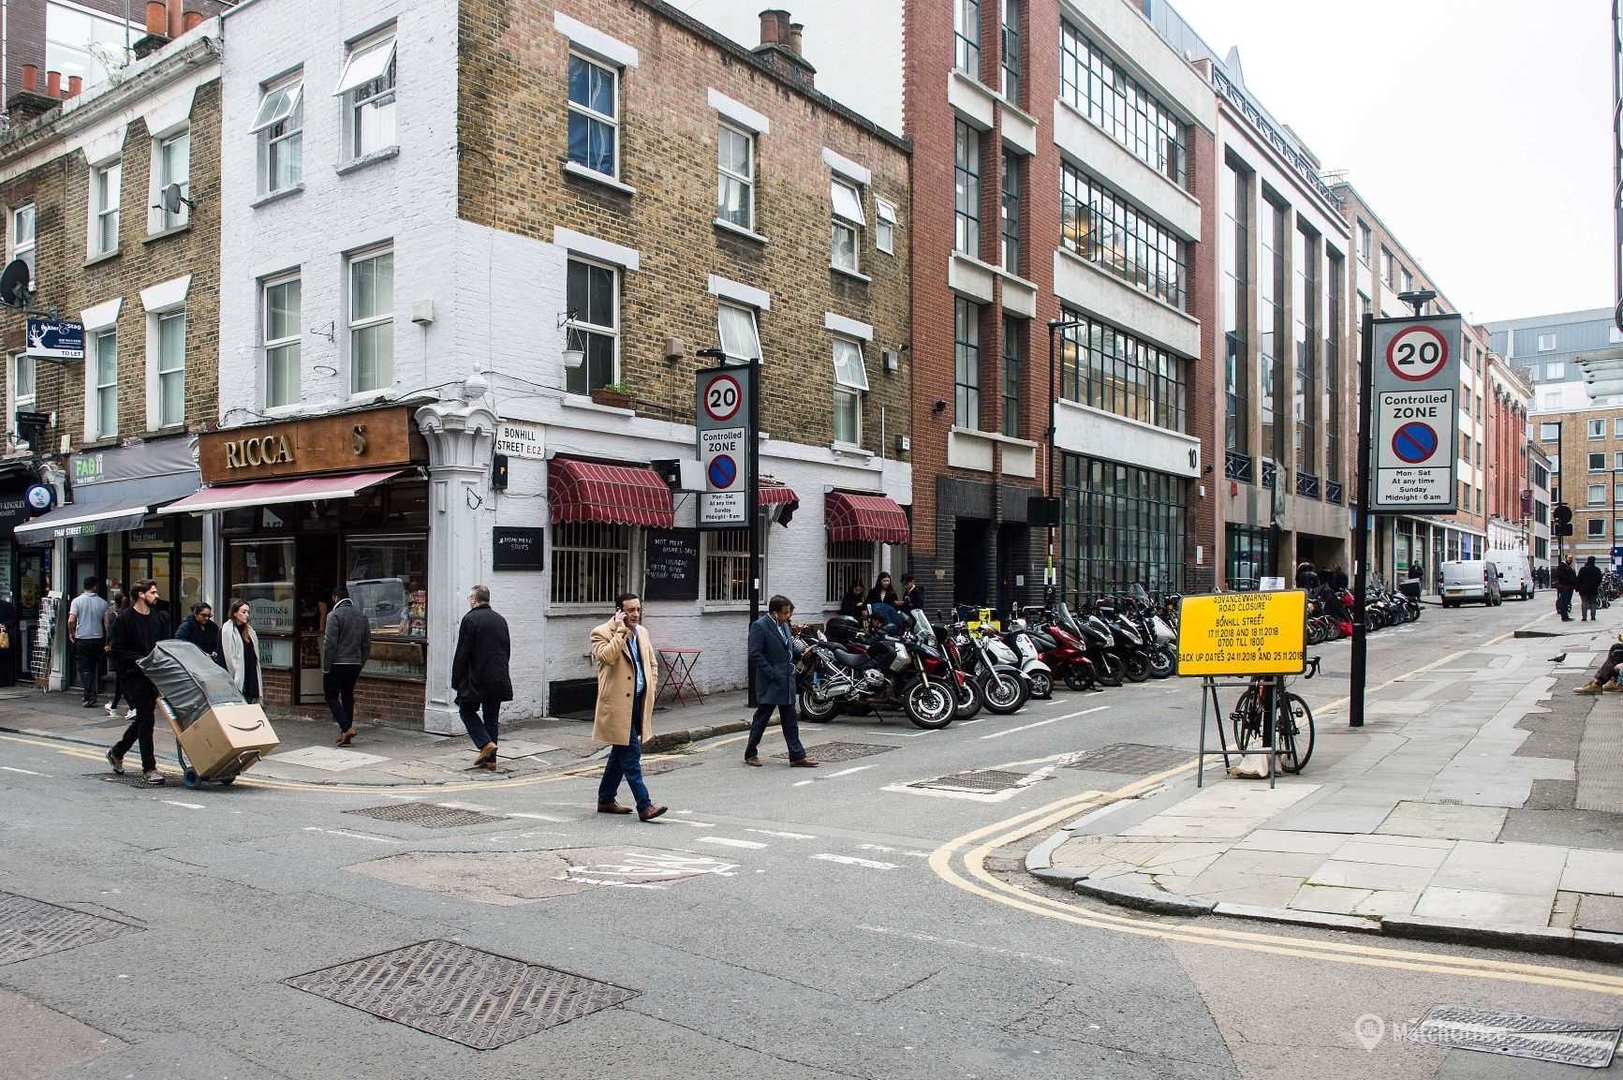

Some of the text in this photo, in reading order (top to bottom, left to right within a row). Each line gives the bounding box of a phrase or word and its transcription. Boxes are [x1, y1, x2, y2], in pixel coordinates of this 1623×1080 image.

[1397, 341, 1440, 366] 20
[710, 387, 736, 408] 20
[1384, 394, 1448, 405] Controlled
[1393, 406, 1438, 419] ZONE
[504, 427, 536, 442] BONHILL
[702, 431, 742, 441] Controlled
[223, 423, 368, 470] RICCA S
[497, 440, 525, 453] STREET
[708, 441, 736, 452] ZONE
[1188, 448, 1197, 469] 10
[1218, 602, 1266, 612] ROAD CLOSURE
[1215, 616, 1265, 627] BONHILL STREET
[1236, 628, 1249, 637] AND
[1217, 637, 1265, 648] 0700 TILL 1800
[1195, 653, 1204, 661] UP
[1205, 652, 1225, 662] DATES
[1259, 651, 1272, 661] AND
